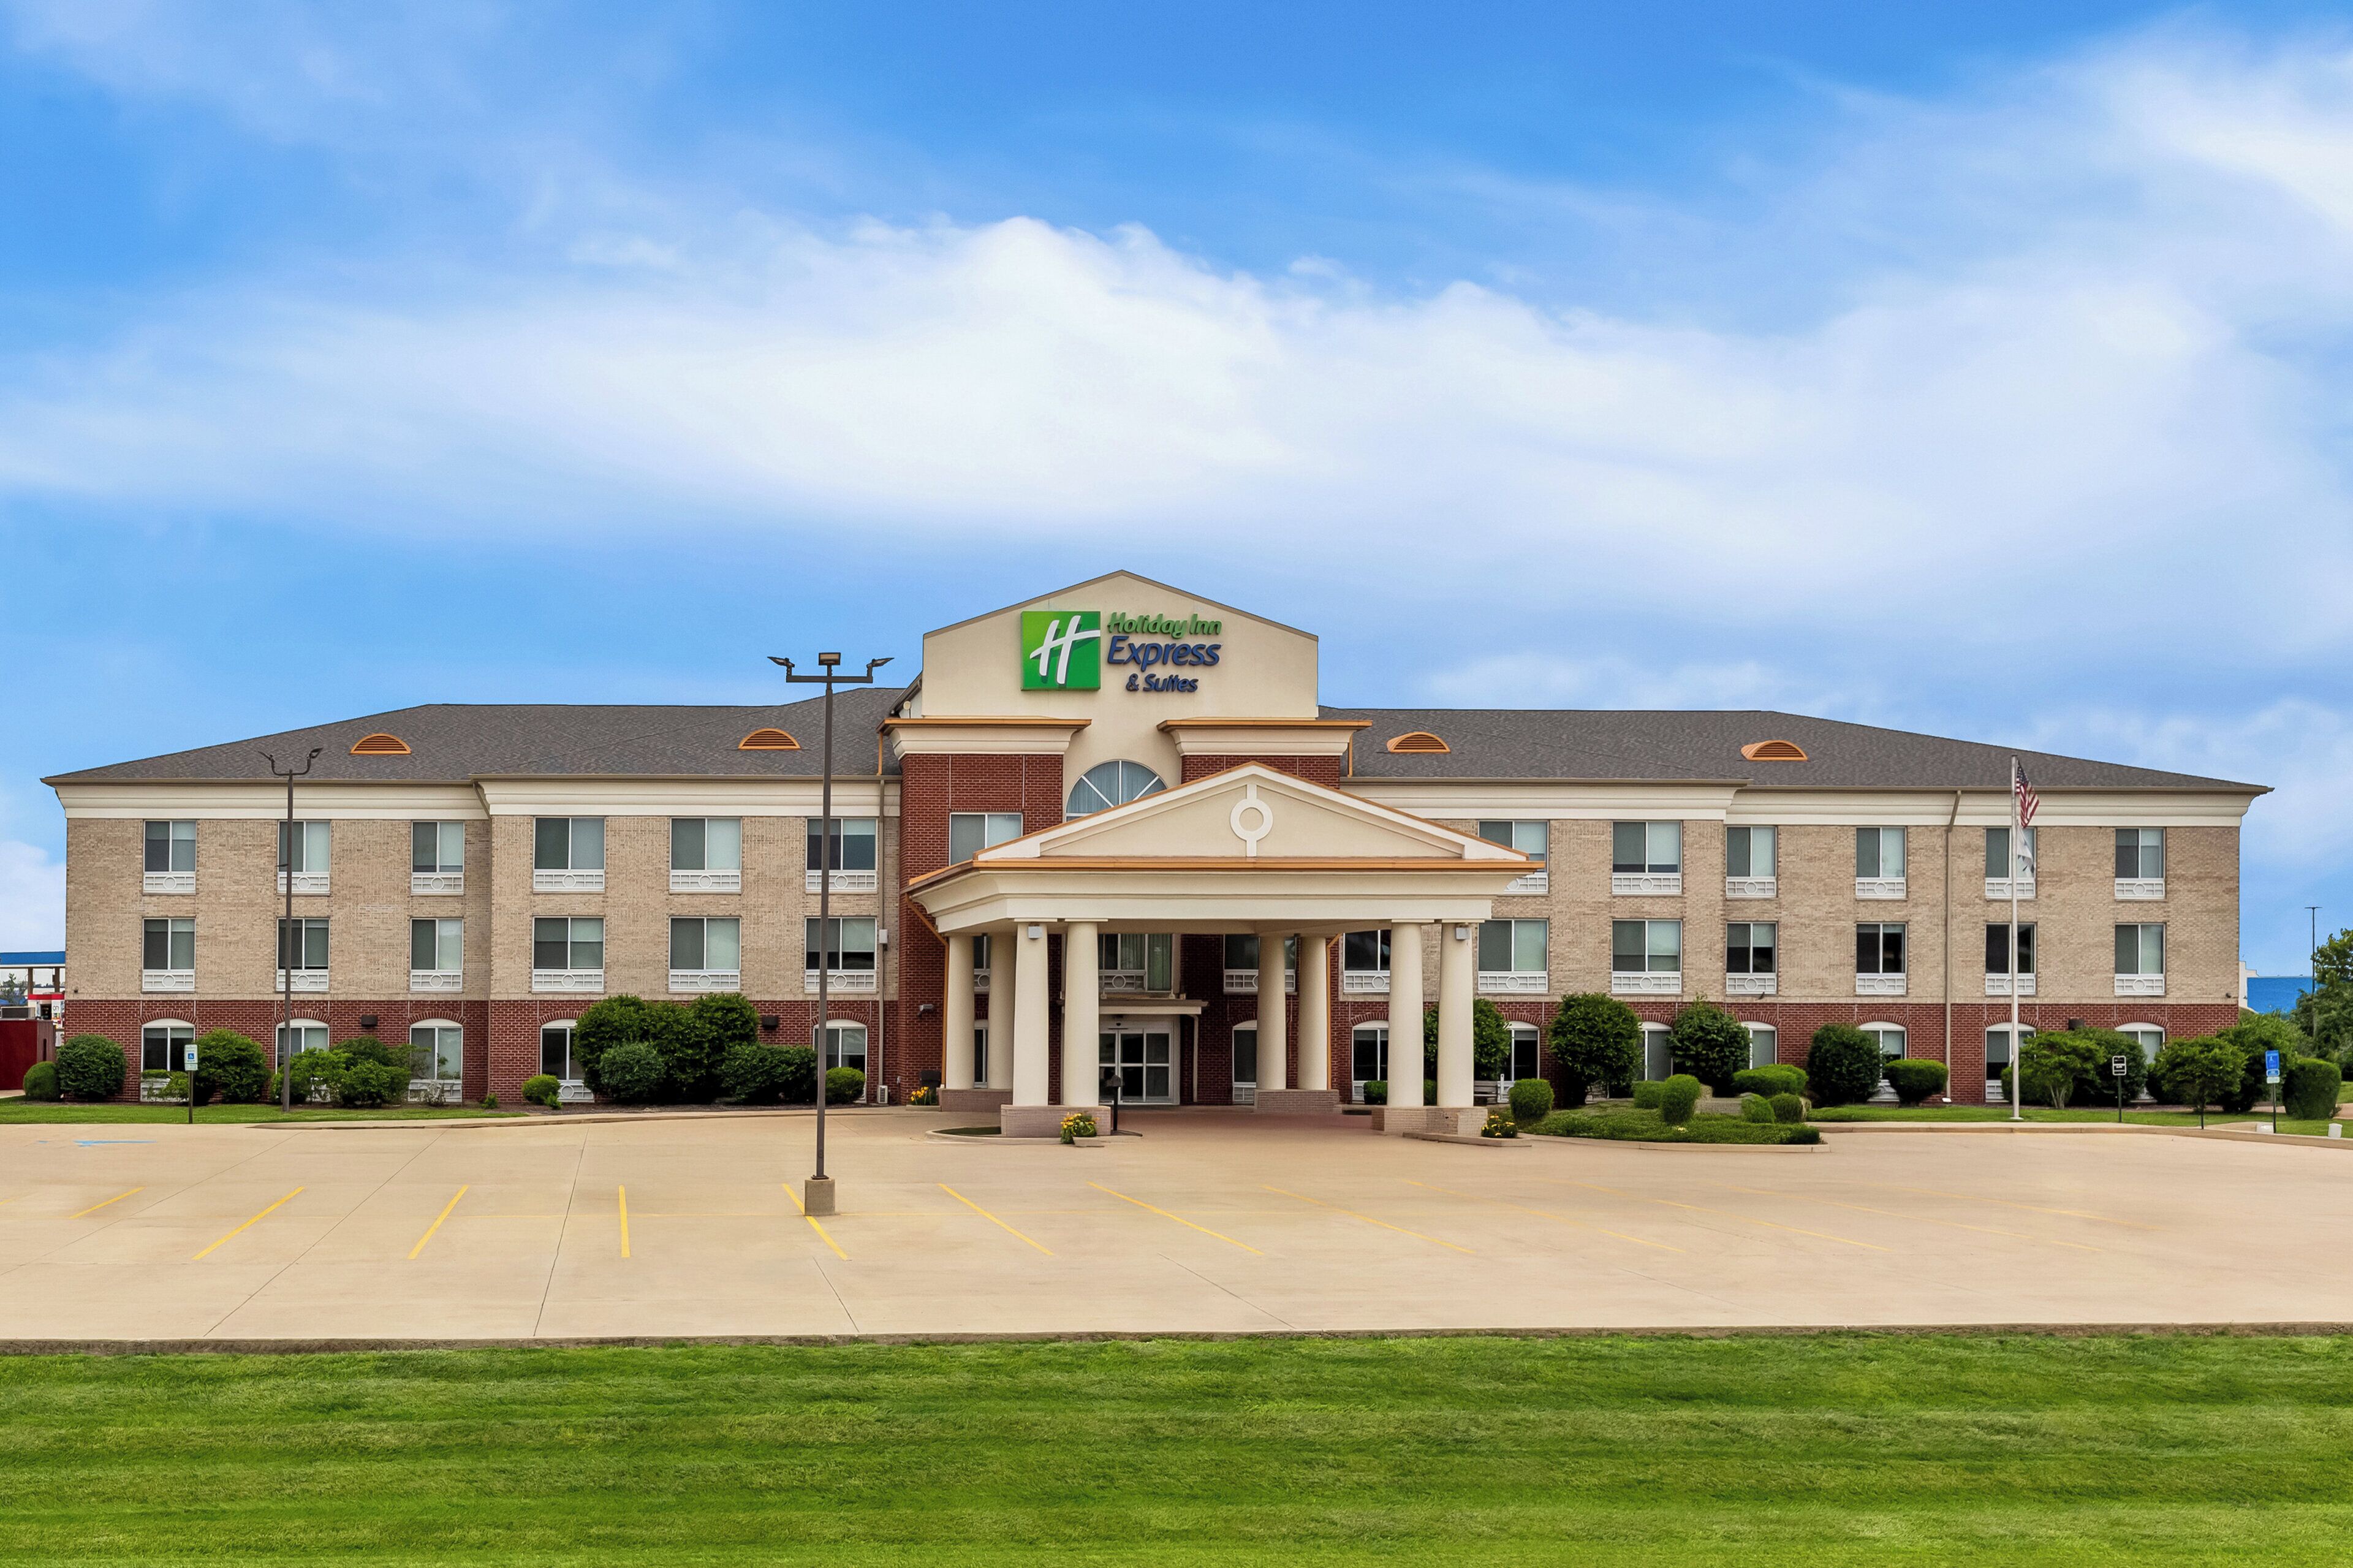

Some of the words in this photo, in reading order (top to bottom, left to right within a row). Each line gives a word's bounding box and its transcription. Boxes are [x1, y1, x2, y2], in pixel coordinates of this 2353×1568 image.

[1107, 612, 1187, 638] Holiday
[1189, 613, 1222, 635] Inn
[1107, 635, 1221, 672] Express
[1126, 673, 1139, 692] &
[1143, 673, 1199, 692] Suites
